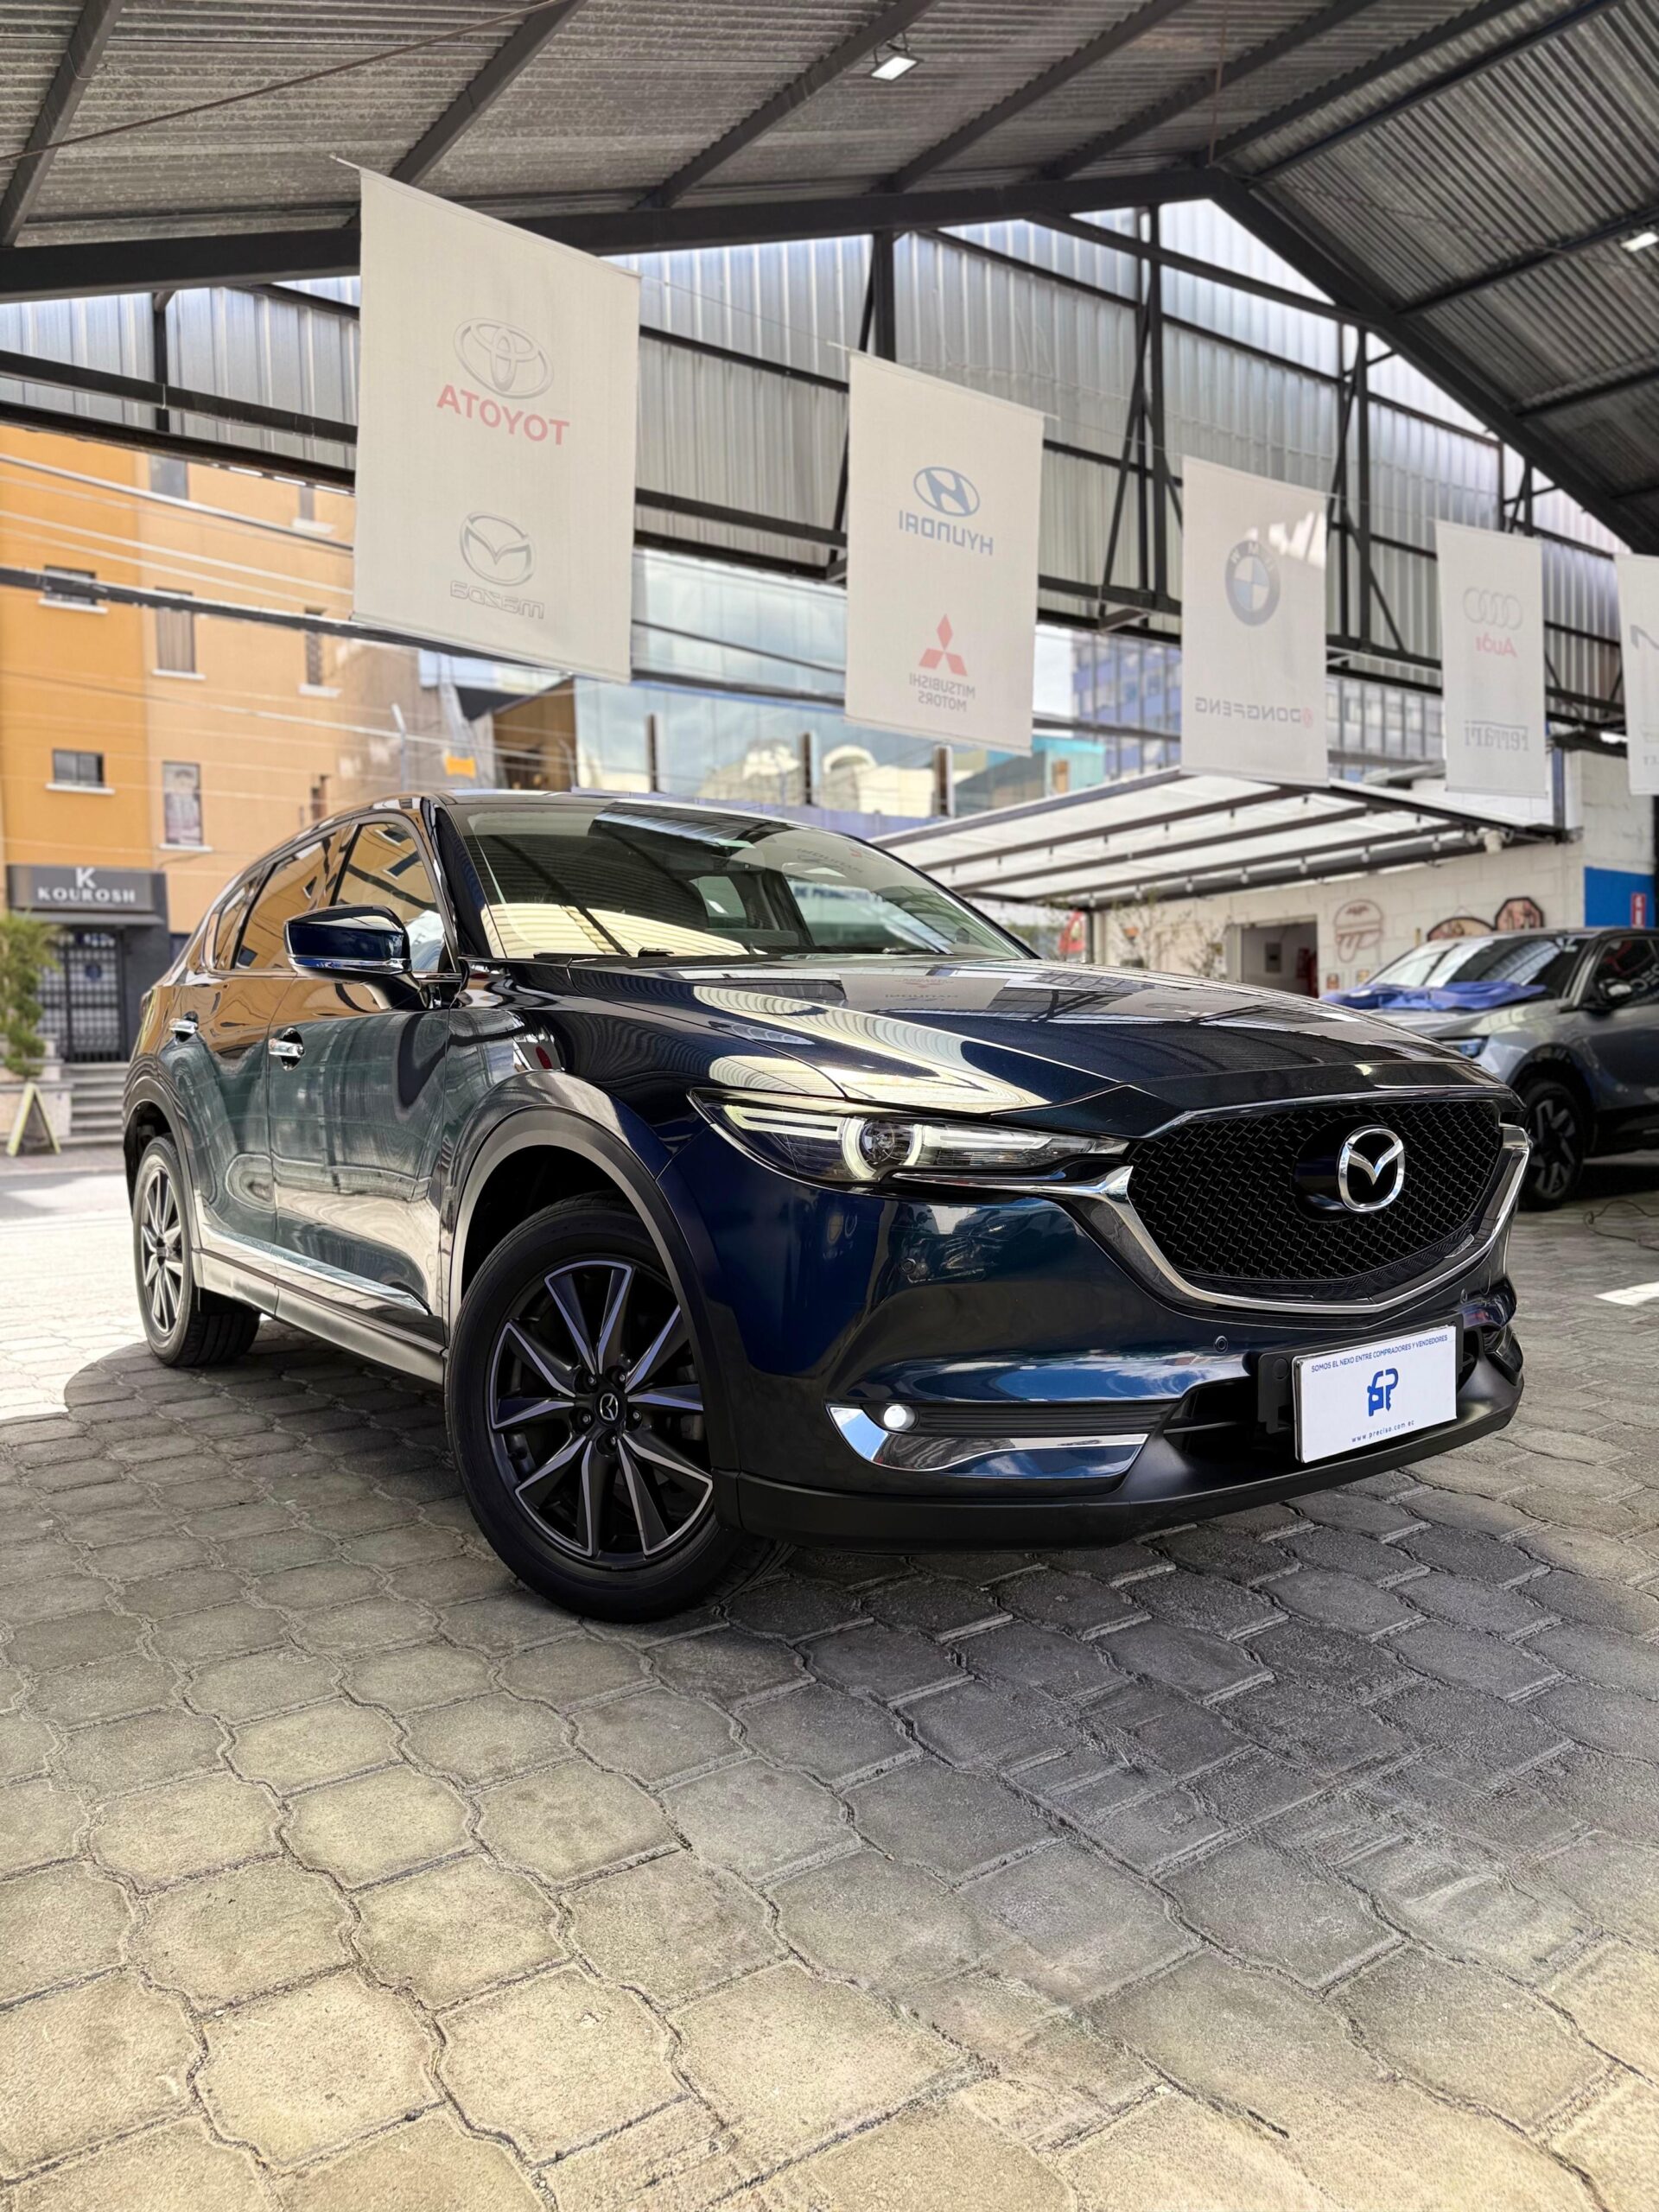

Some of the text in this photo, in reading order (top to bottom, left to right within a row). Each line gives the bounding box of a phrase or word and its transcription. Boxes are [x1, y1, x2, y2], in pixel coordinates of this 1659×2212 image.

[75, 867, 97, 889] K
[37, 887, 137, 904] KOUROSH
[1311, 1361, 1332, 1373] SOMOS
[1332, 1359, 1339, 1368] EL
[1340, 1356, 1355, 1367] NEXO
[1355, 1351, 1372, 1363] ENTRE
[1372, 1344, 1412, 1358] COMPRADORES
[1416, 1334, 1448, 1349] VENDEDORES
